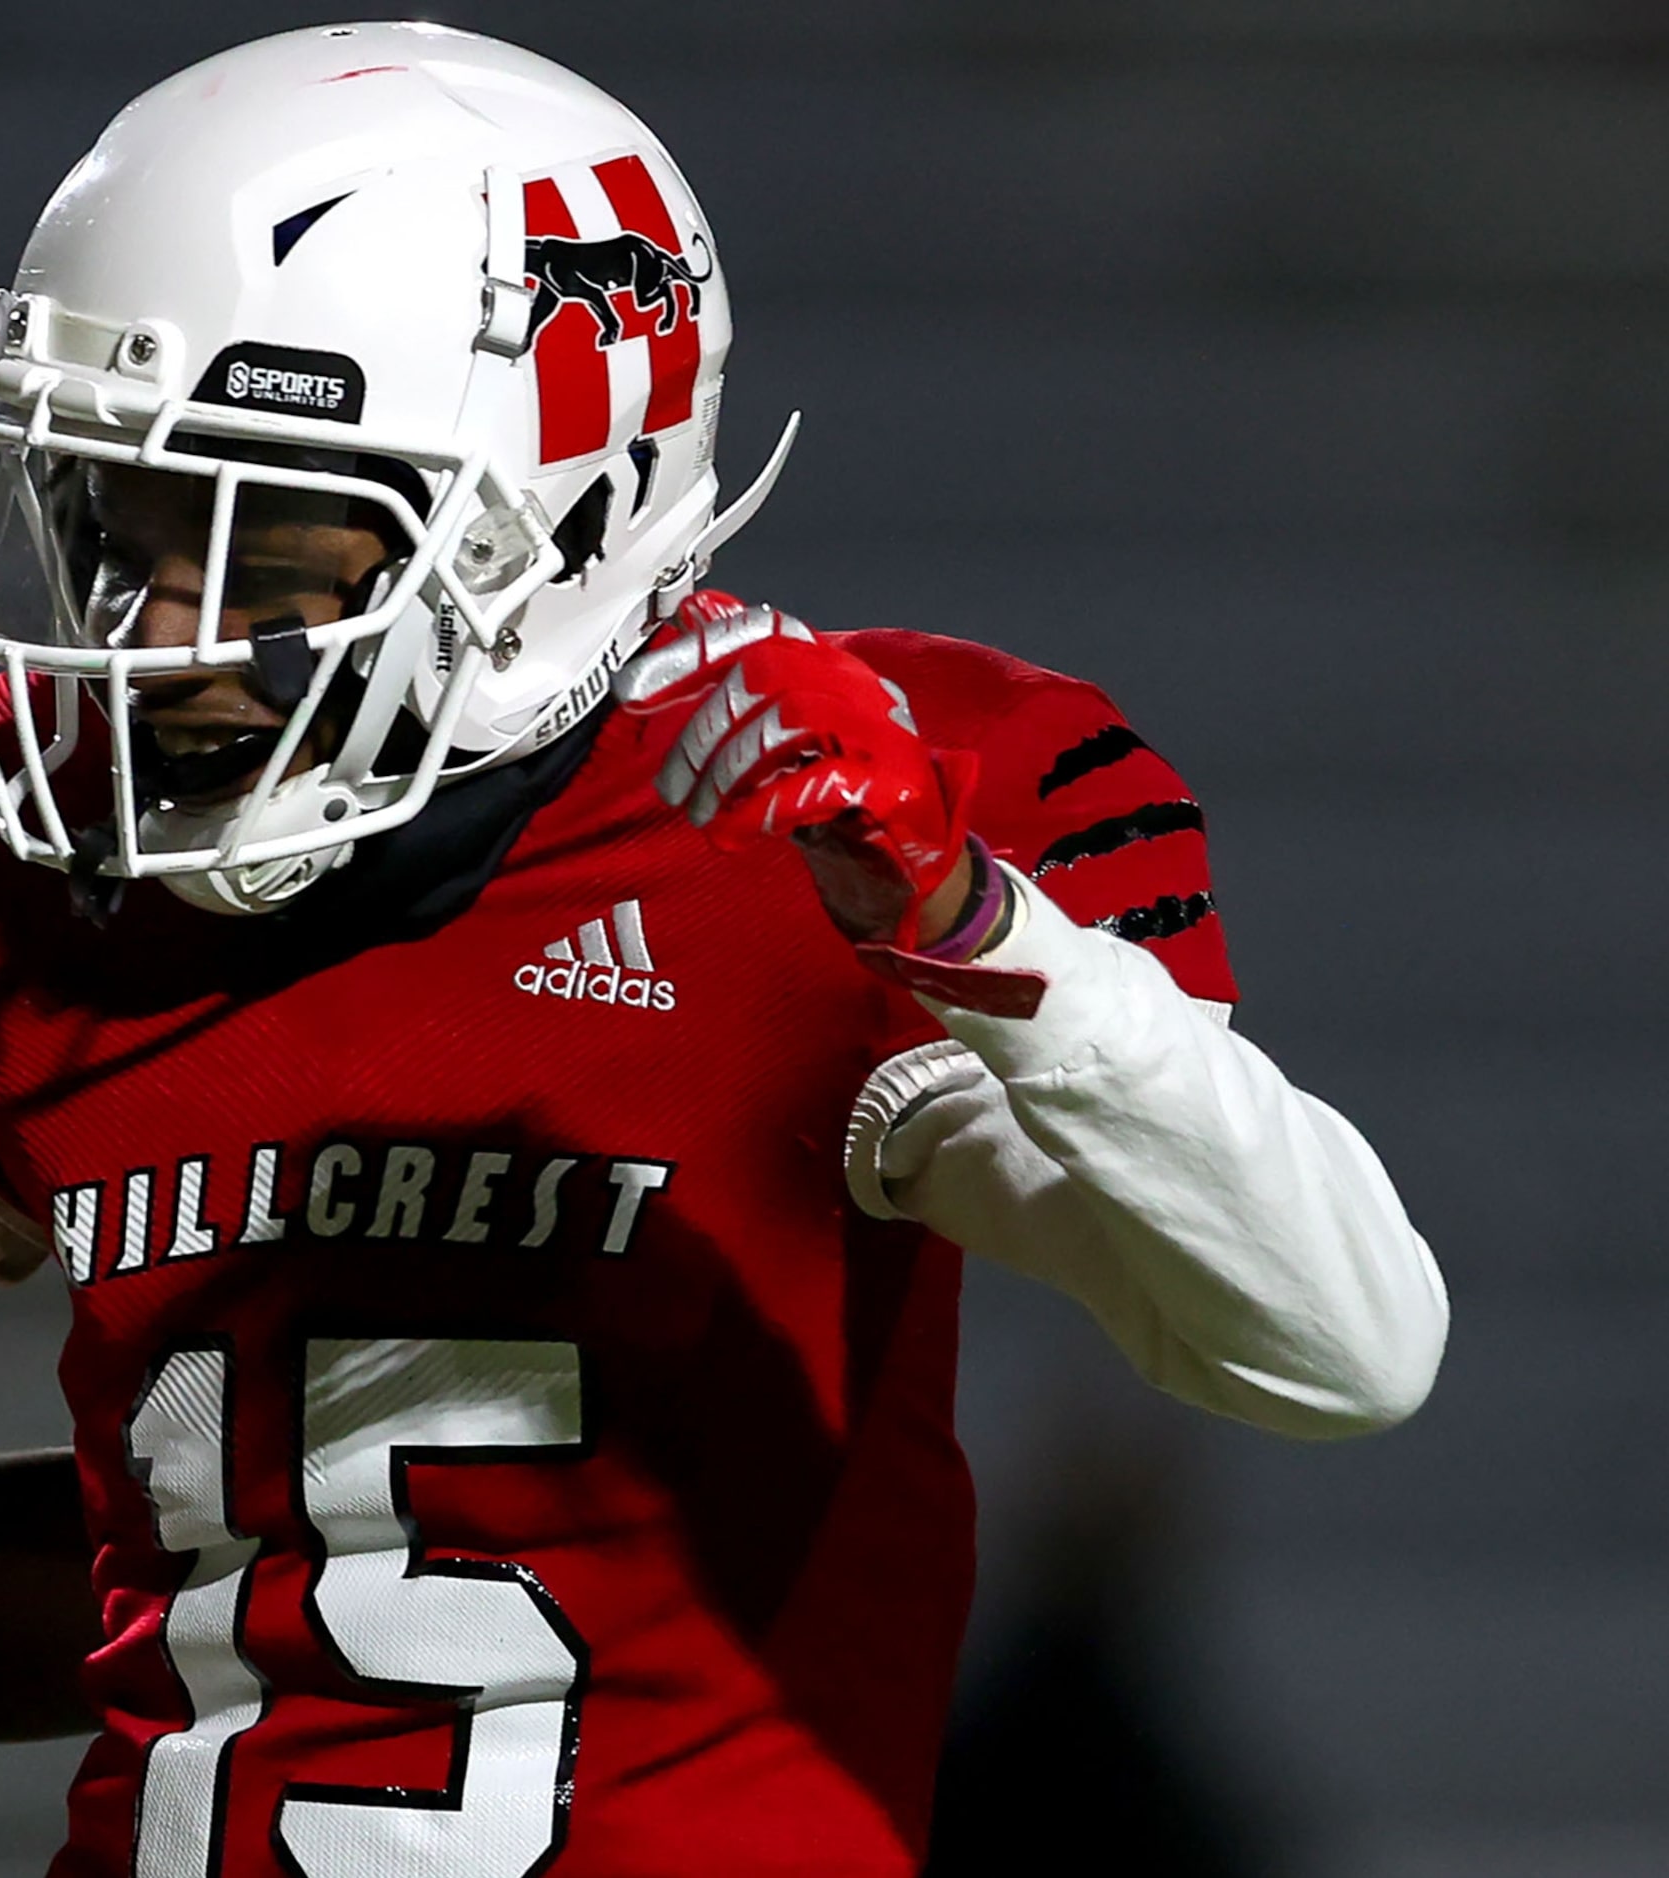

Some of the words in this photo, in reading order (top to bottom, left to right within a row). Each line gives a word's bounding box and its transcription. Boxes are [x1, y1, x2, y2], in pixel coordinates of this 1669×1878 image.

[250, 367, 346, 400] SPORTS
[252, 389, 339, 409] UNLIMITED
[436, 603, 458, 672] schutt
[534, 638, 622, 747] schutt
[513, 960, 676, 1011] adidas
[51, 1141, 673, 1286] HILLCREST
[125, 1333, 587, 1878] 15
